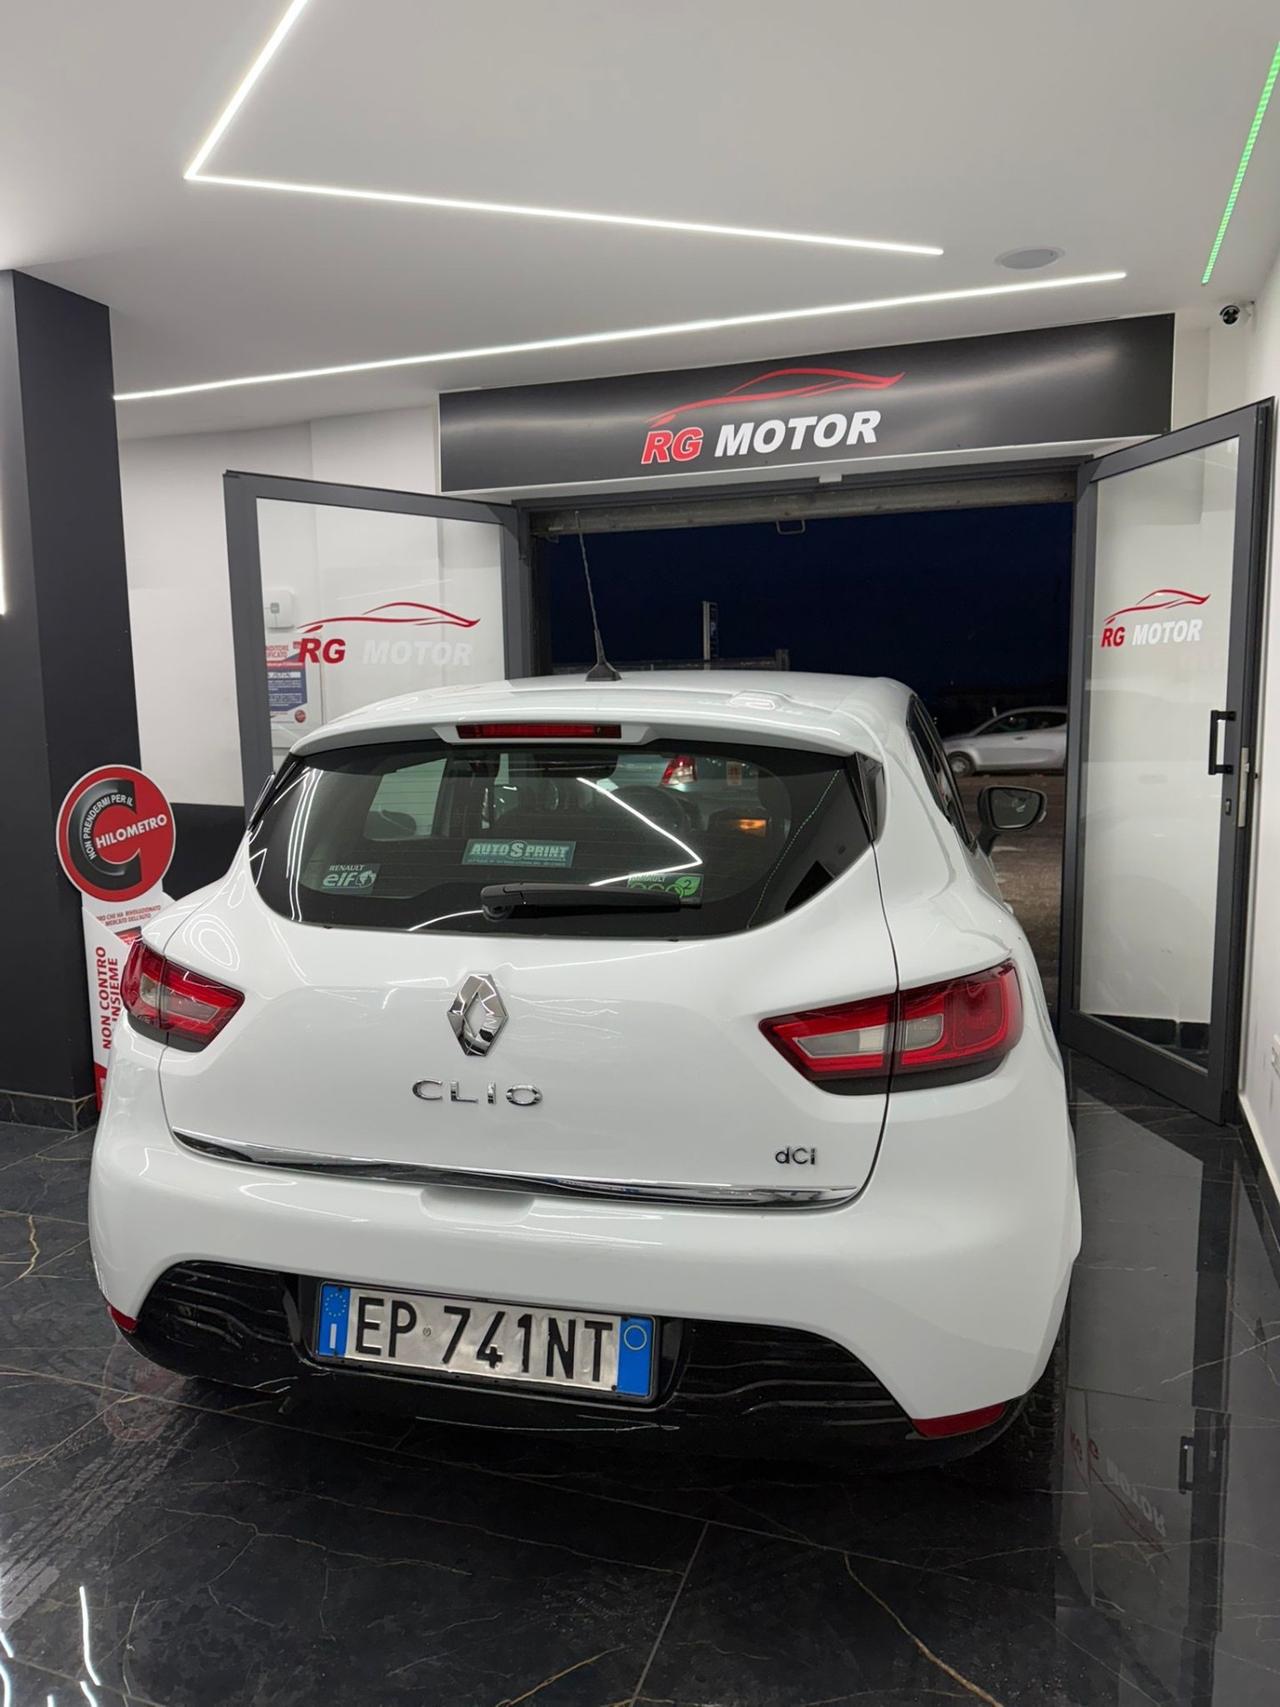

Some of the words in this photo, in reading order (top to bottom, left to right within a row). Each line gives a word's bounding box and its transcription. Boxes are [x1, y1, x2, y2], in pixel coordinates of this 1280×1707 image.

[640, 427, 704, 464] RG
[714, 410, 881, 457] MOTOR
[1101, 626, 1126, 648] RG
[1132, 619, 1202, 646] MOTOR
[300, 637, 346, 664] RG
[363, 639, 473, 666] MOTOR
[111, 794, 126, 803] PER
[83, 797, 110, 839] PRENDERMI
[84, 841, 97, 860] NON
[329, 864, 365, 872] RENAULT
[95, 946, 111, 1010] CONTRO
[100, 1015, 112, 1049] NON
[412, 1080, 543, 1106] CLIO
[775, 1147, 816, 1165] dCi
[355, 1295, 418, 1358] EP
[442, 1305, 614, 1383] 741NT
